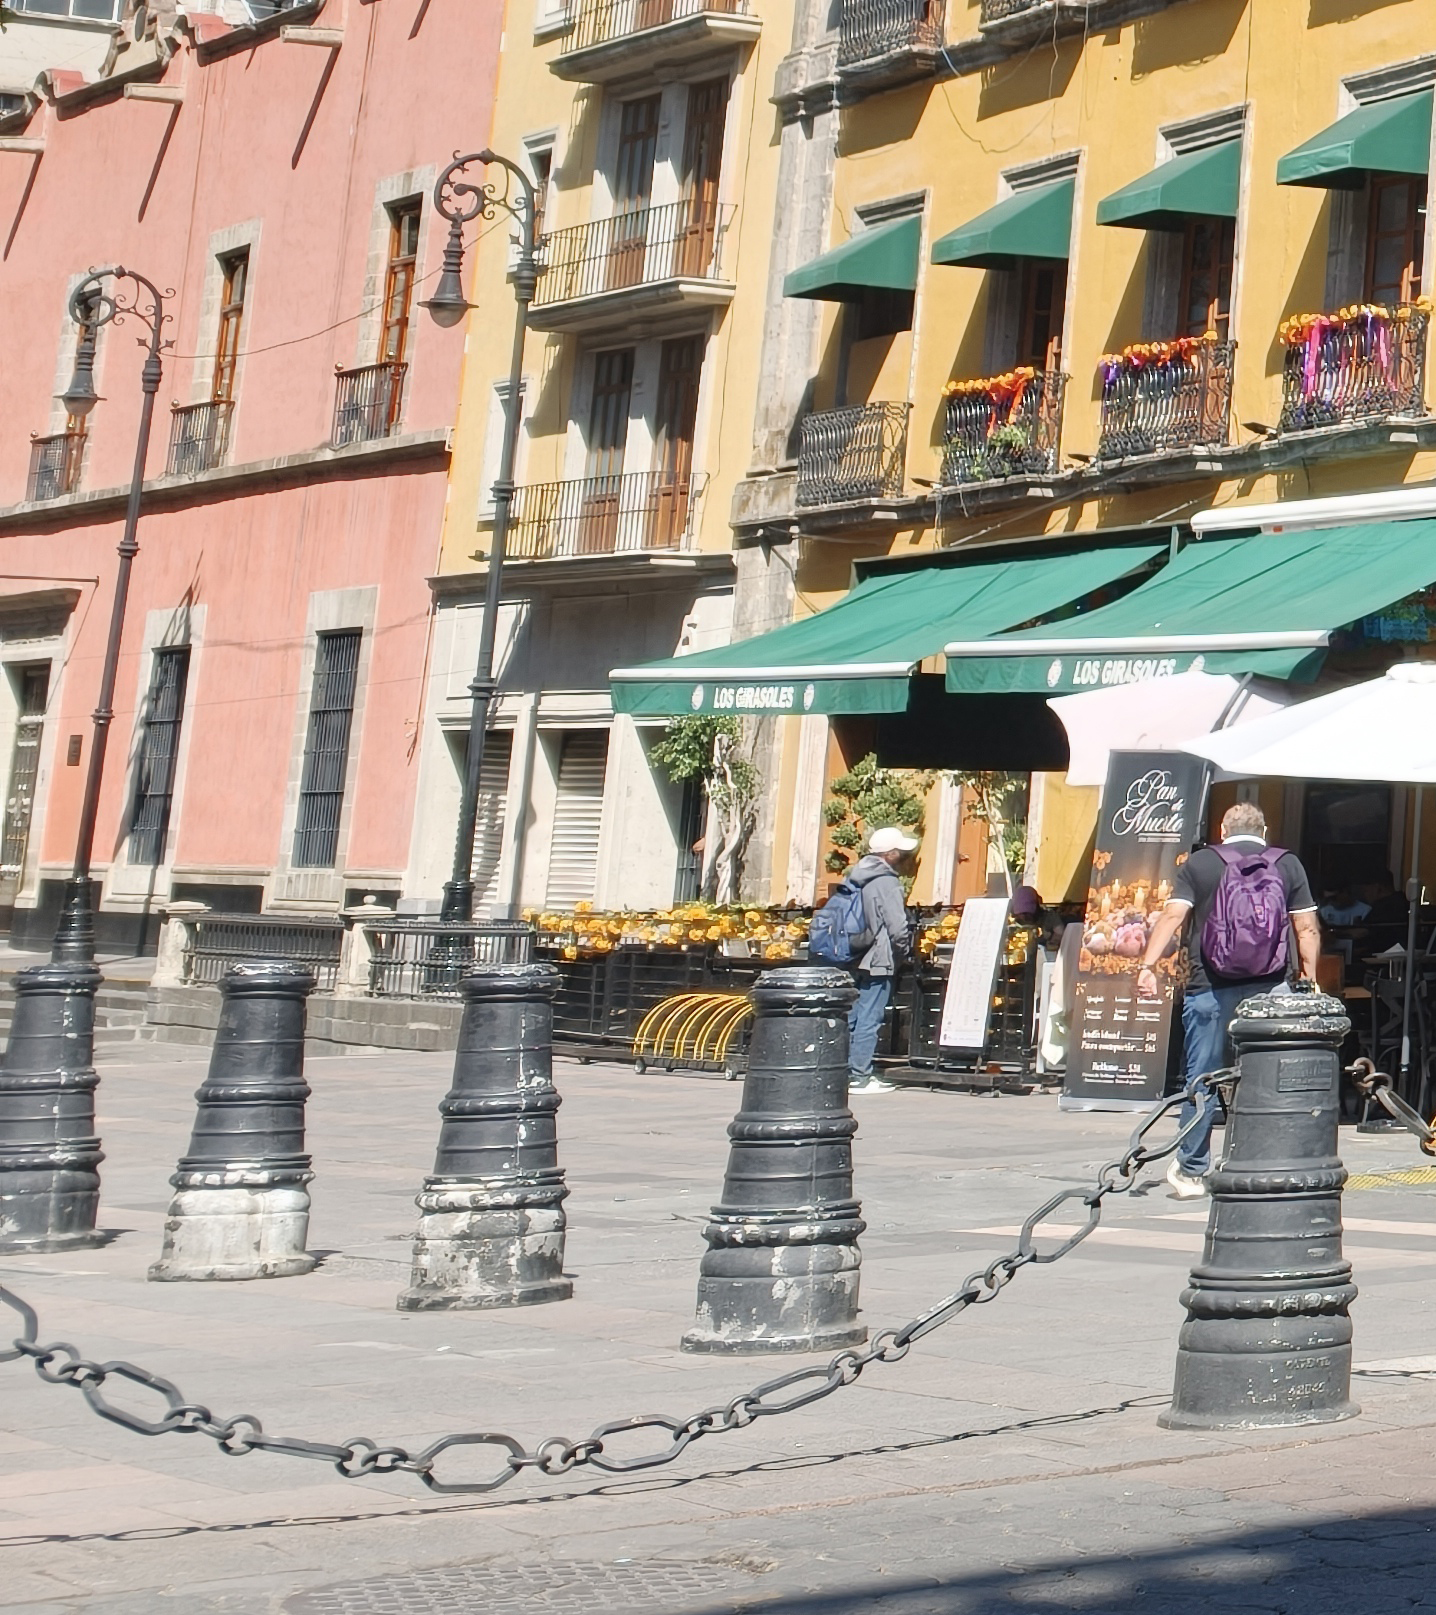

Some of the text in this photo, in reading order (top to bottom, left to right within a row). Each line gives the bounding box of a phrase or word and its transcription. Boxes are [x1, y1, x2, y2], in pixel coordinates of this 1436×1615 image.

[1072, 658, 1177, 685] LOS GIRASOLES
[713, 685, 795, 709] LOS GIRASOLES
[1127, 769, 1178, 808] Pan
